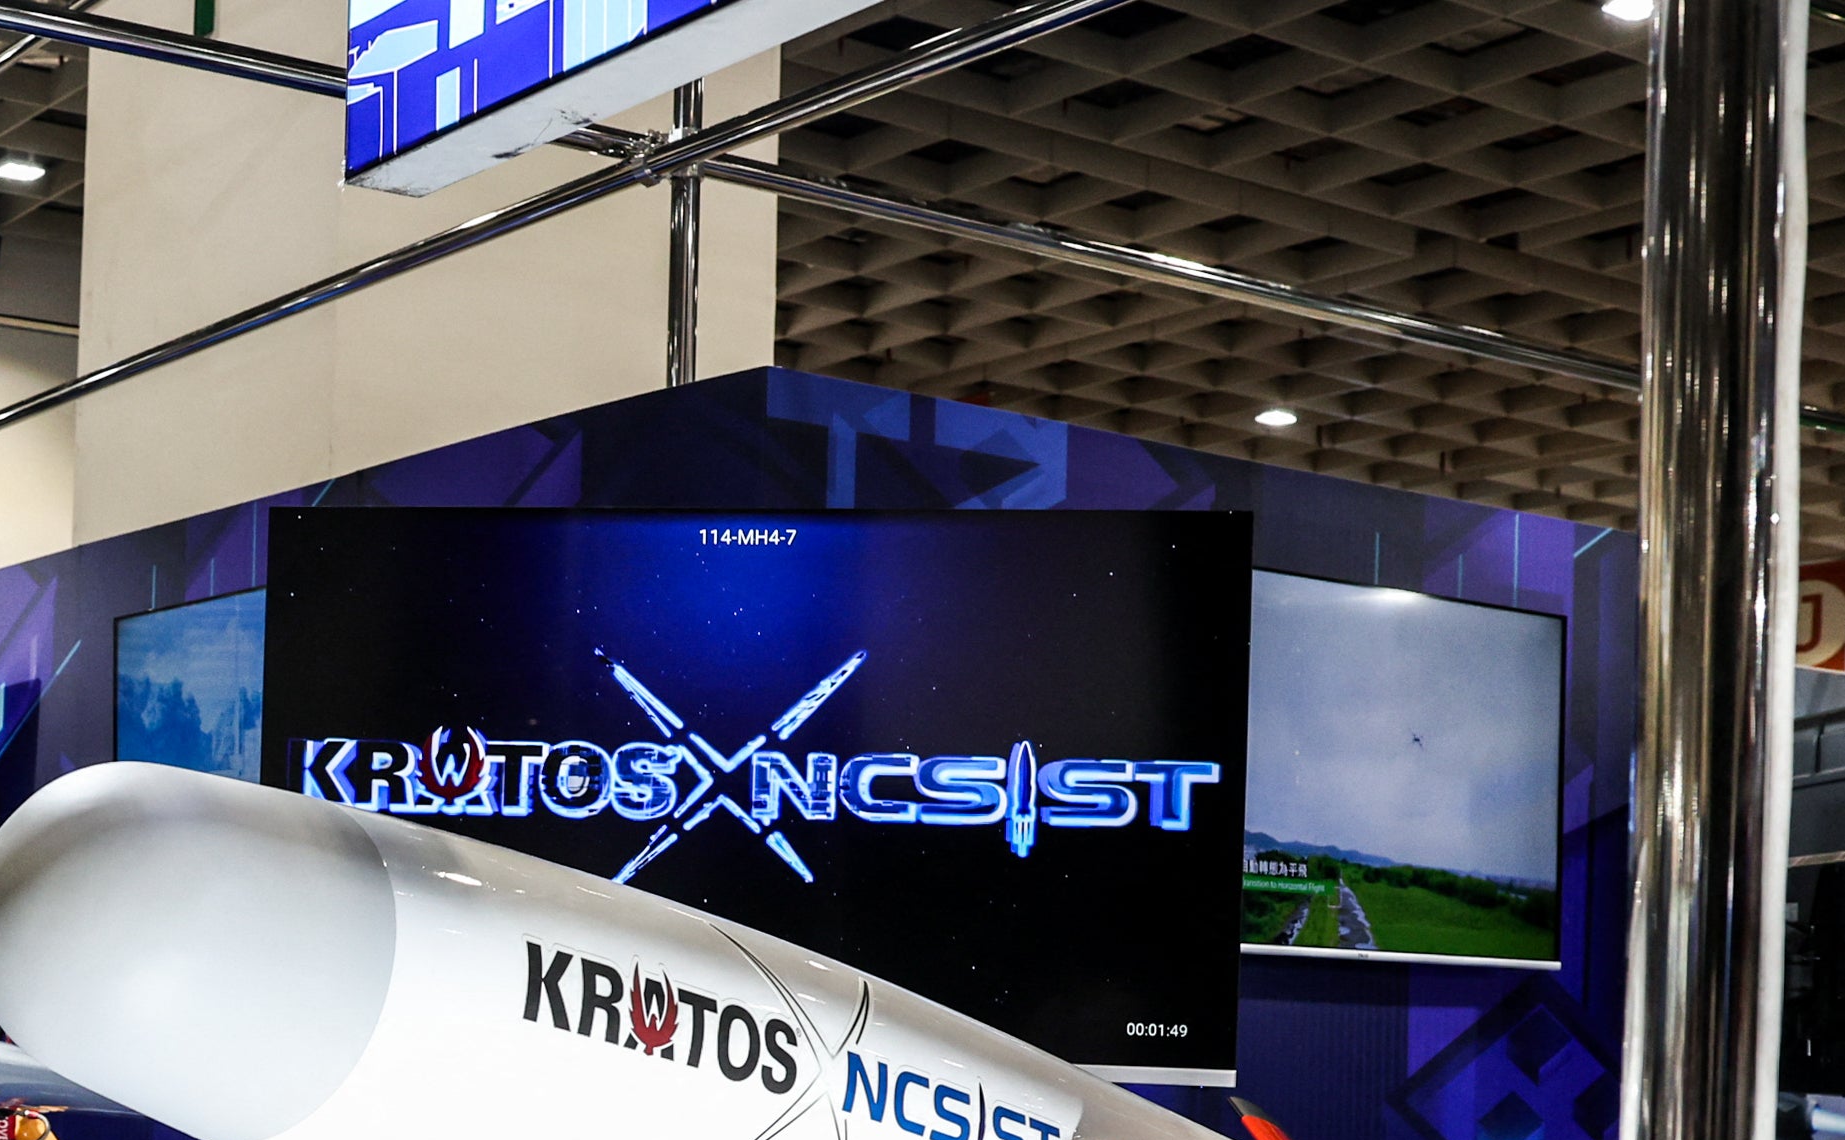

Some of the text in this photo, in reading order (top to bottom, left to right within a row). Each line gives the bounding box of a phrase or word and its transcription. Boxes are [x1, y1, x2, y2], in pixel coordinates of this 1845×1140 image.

[699, 528, 797, 546] 114-MH4-7
[522, 941, 798, 1095] KRATOS
[1126, 1022, 1188, 1038] 00:01:49
